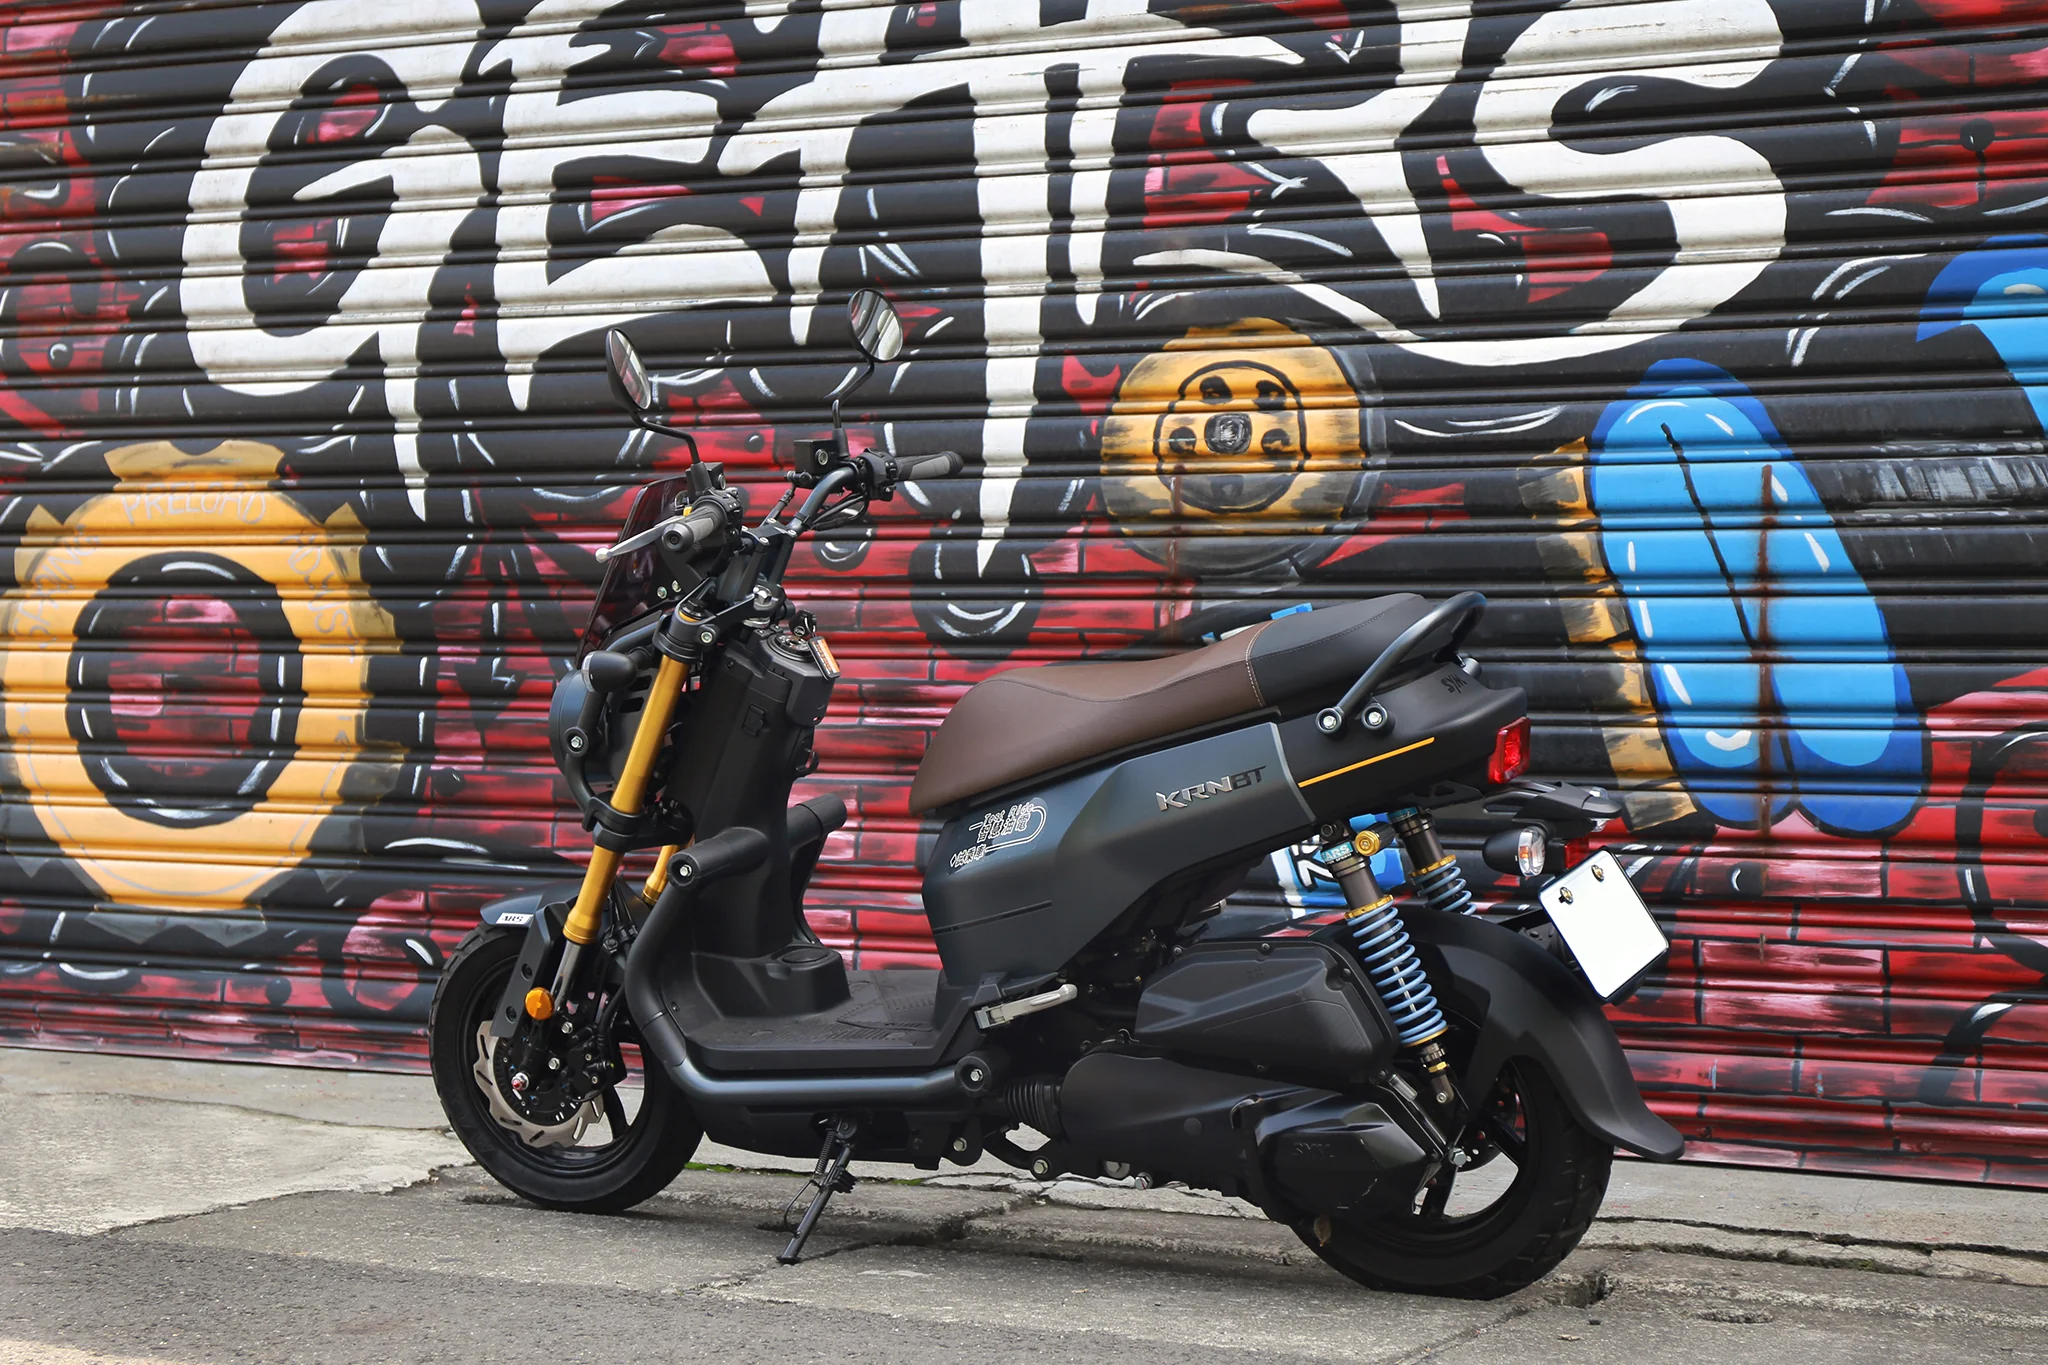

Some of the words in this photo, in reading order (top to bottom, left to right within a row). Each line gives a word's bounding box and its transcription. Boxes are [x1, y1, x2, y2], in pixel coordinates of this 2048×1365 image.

[121, 481, 266, 526] PRELOAD
[1440, 672, 1468, 694] SYM
[1154, 764, 1268, 812] KRNBT
[1324, 844, 1350, 860] ARS
